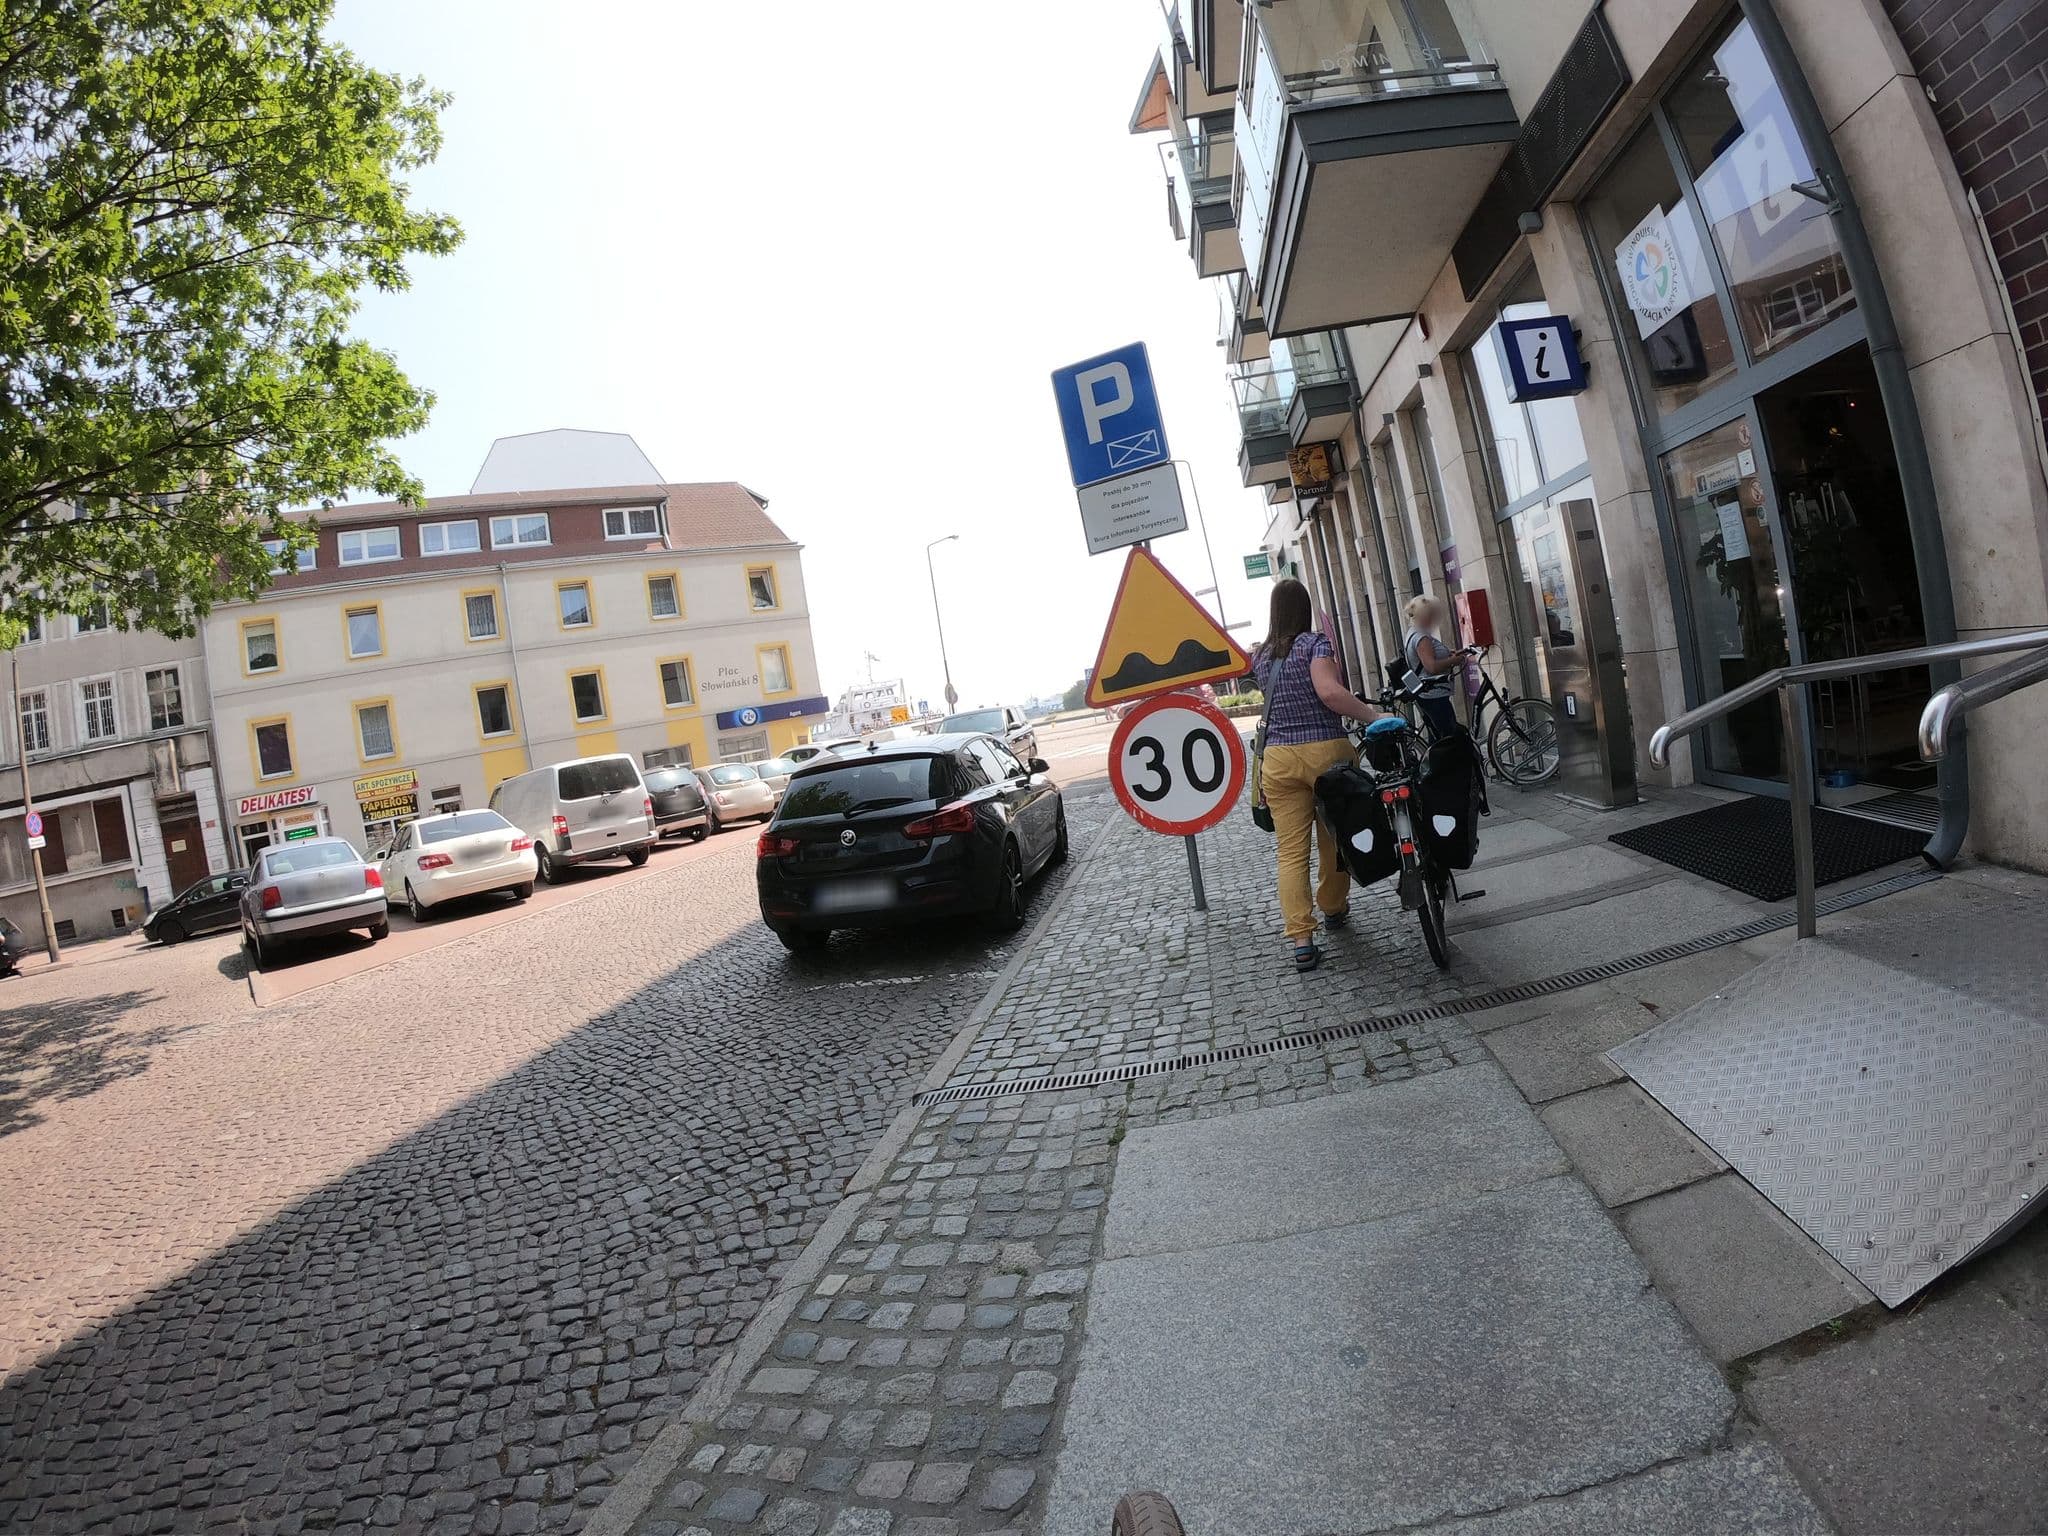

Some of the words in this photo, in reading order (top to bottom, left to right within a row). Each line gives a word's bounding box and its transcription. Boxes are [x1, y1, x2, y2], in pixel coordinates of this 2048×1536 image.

[1535, 332, 1550, 379] i
[1075, 361, 1134, 445] P
[1140, 480, 1152, 488] min
[1297, 486, 1327, 495] Partner
[1111, 501, 1120, 509] dla
[1121, 495, 1149, 507] pojazdów
[1113, 509, 1150, 523] interesantów
[1110, 525, 1140, 538] Informacji
[1141, 516, 1179, 530] Turystycznej
[718, 666, 739, 677] Plac
[701, 677, 750, 692] Słowiański
[752, 674, 759, 685] 8
[1128, 728, 1225, 802] 30
[241, 787, 315, 814] DELIKATESY
[363, 794, 415, 813] PAPIEROSY
[370, 806, 412, 821] ZIGARETTEN
